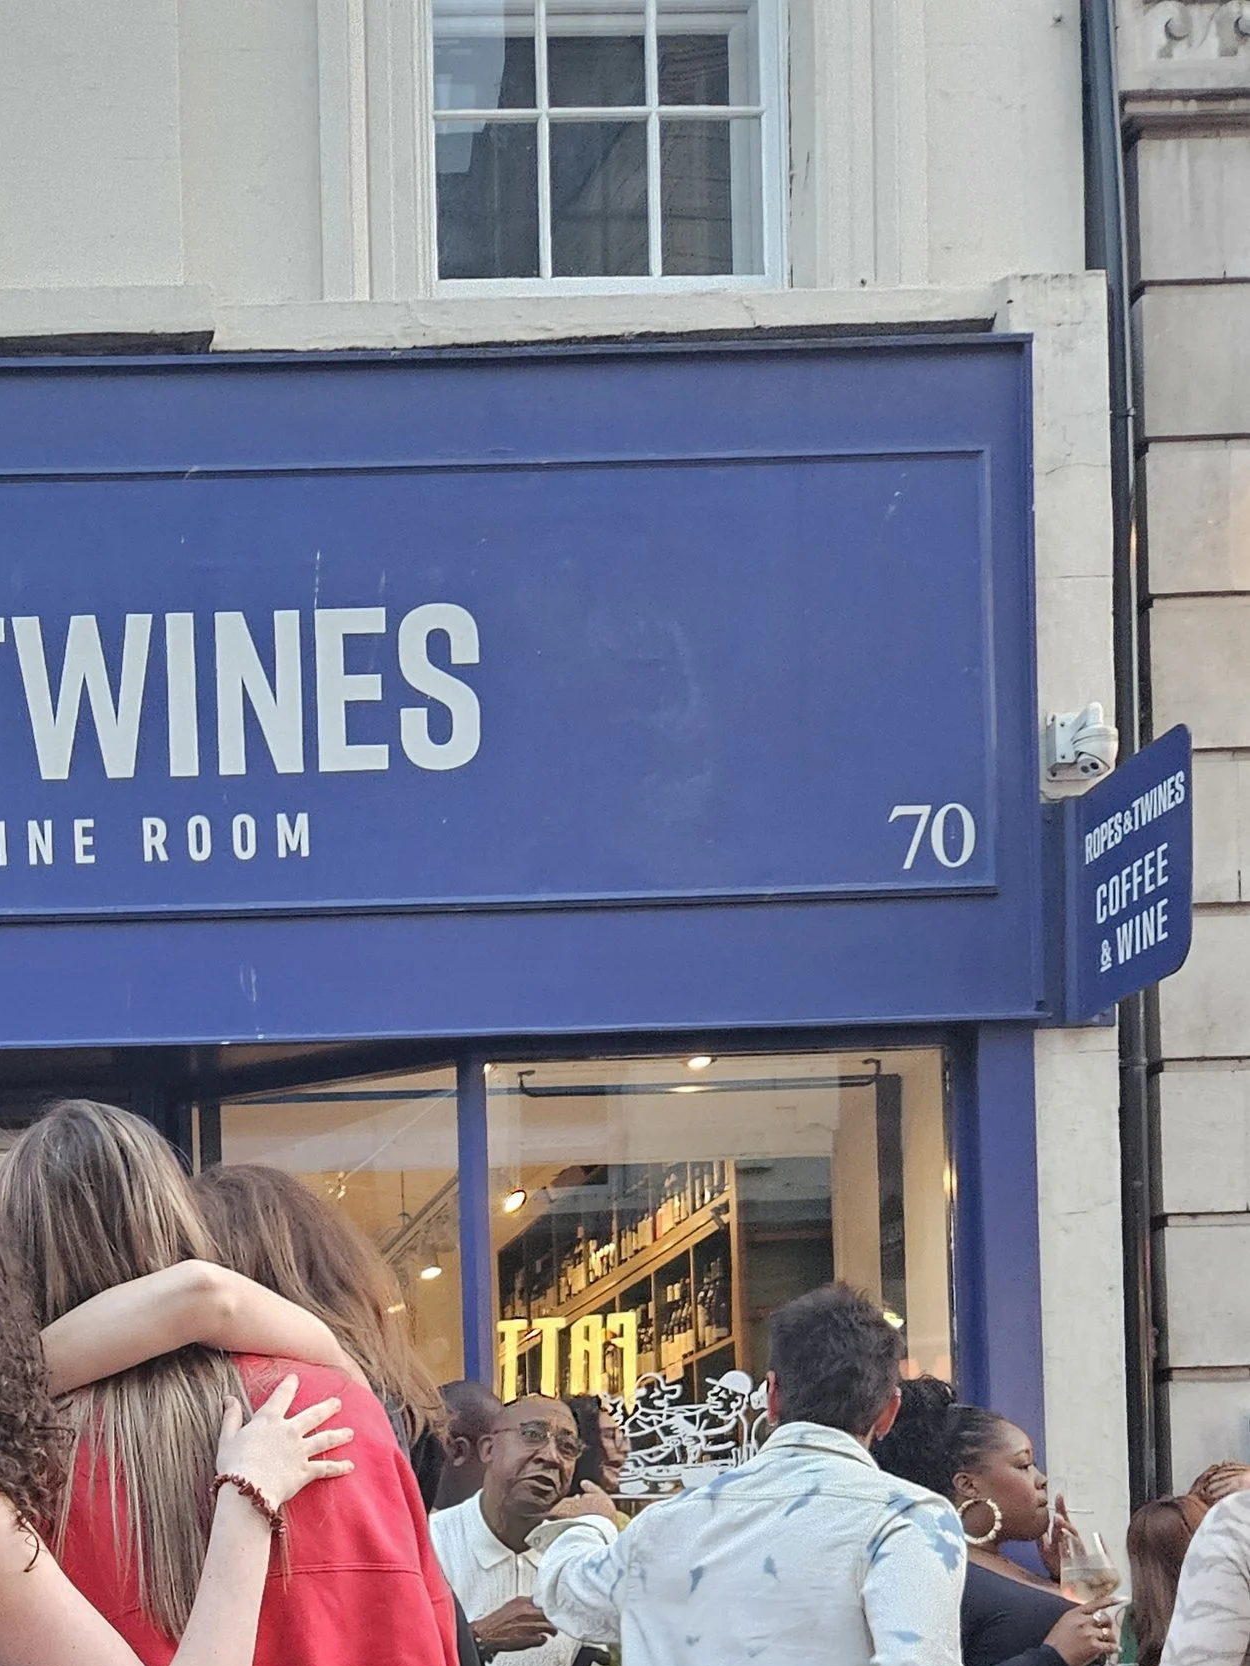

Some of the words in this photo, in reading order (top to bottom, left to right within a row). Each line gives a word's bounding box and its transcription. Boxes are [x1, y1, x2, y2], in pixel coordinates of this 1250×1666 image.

[142, 813, 310, 862] ROOM
[888, 803, 976, 870] 70
[1096, 842, 1169, 925] COFFEE
[1100, 939, 1112, 973] &
[1116, 898, 1169, 965] WINE
